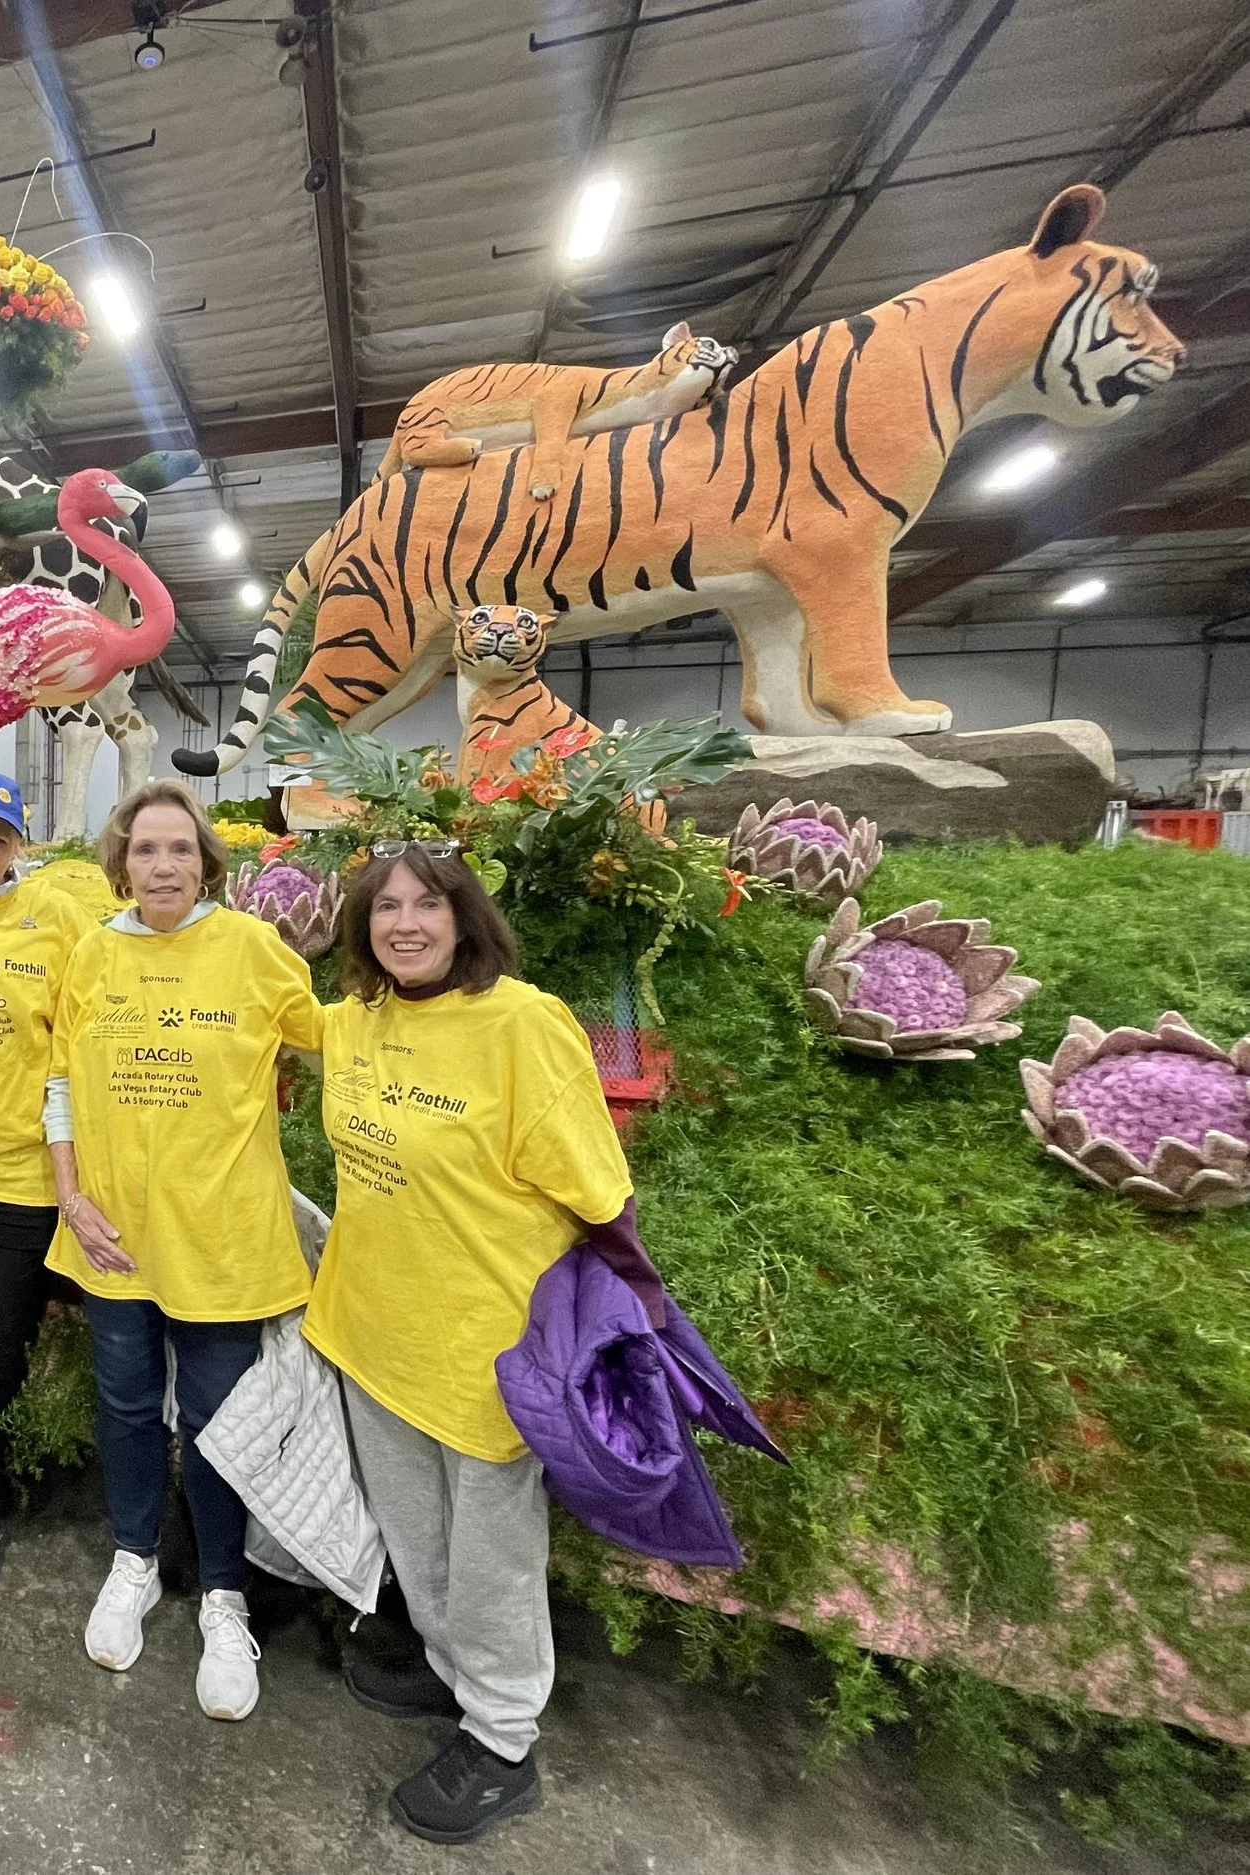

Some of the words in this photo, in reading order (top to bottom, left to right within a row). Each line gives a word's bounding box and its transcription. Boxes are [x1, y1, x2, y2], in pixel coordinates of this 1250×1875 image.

[4, 958, 46, 977] Foothill
[6, 971, 25, 981] credit
[139, 975, 183, 984] Sponsors:
[190, 1008, 237, 1026] Foothill
[192, 1022, 213, 1031] credit
[135, 1048, 193, 1063] DACdb
[381, 1041, 416, 1056] Sponsors:
[144, 1072, 174, 1082] Rotary
[176, 1073, 199, 1084] Club
[108, 1083, 122, 1092] Las
[123, 1084, 147, 1094] Vegas
[149, 1085, 178, 1097] Rotary
[180, 1087, 203, 1097] Club
[118, 1096, 131, 1105] LA
[166, 1098, 189, 1109] Club
[407, 1086, 468, 1115] Foothill
[406, 1102, 431, 1116] credit
[432, 1110, 458, 1124] union
[348, 1115, 397, 1146] DACdb
[354, 1144, 379, 1164] Rotary
[380, 1156, 402, 1171] Club
[360, 1158, 384, 1180] Rotary
[385, 1171, 408, 1187] Club
[351, 1168, 373, 1189] Rotary
[374, 1181, 394, 1197] Club
